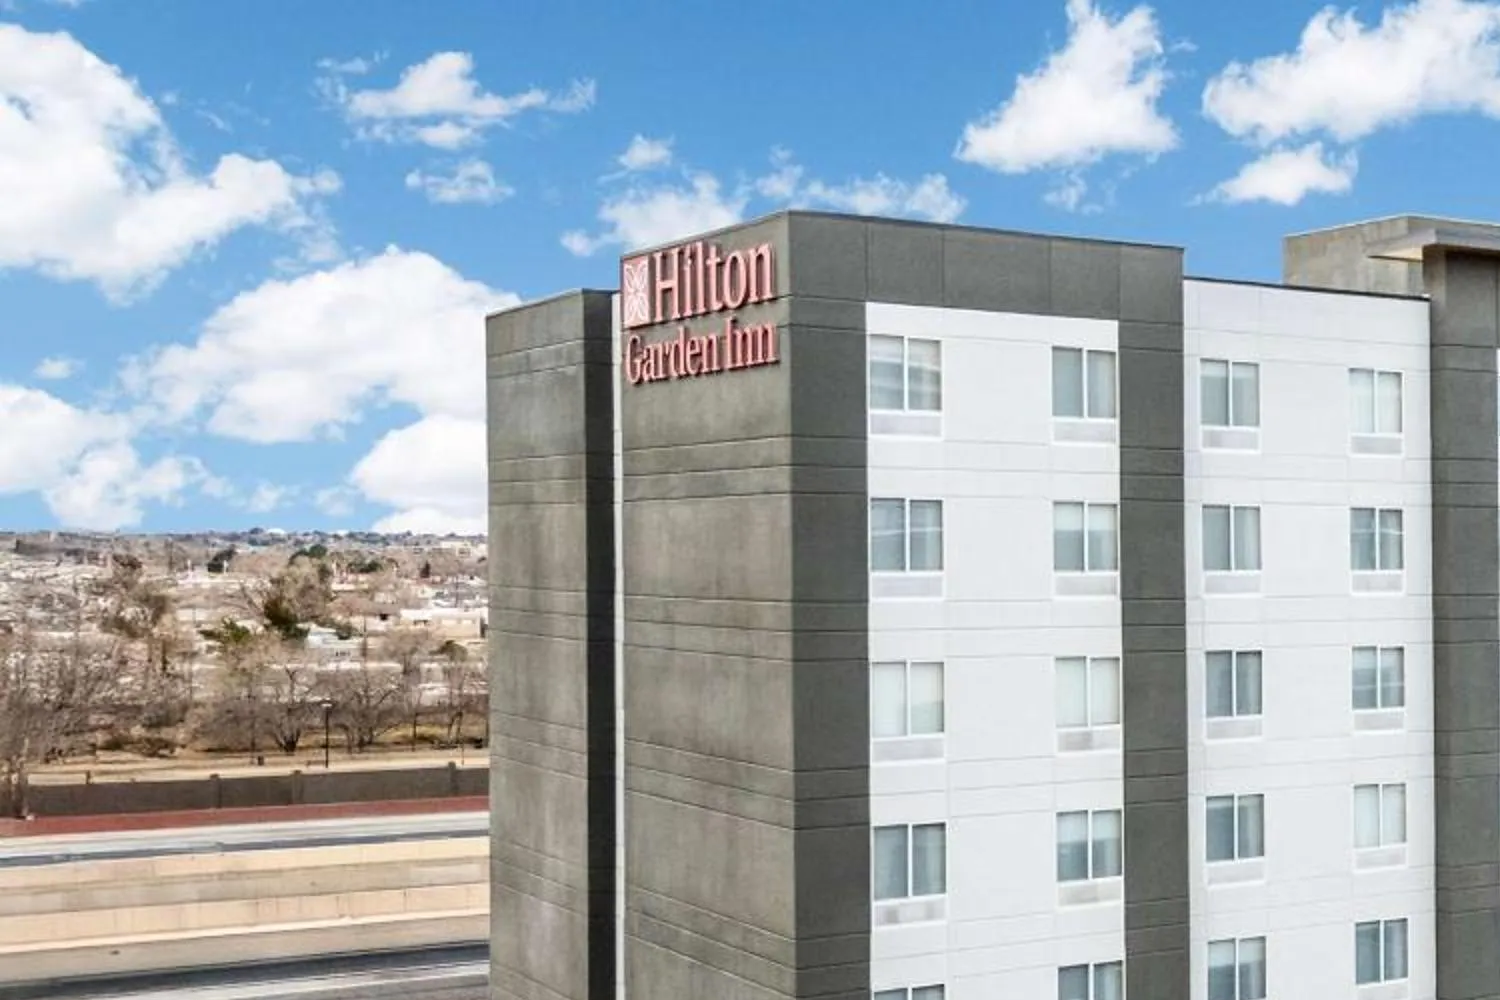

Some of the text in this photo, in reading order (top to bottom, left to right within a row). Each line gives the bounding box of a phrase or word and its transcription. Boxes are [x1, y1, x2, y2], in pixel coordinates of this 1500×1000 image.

[654, 241, 774, 322] Hilton
[625, 316, 778, 384] Garden Inn
